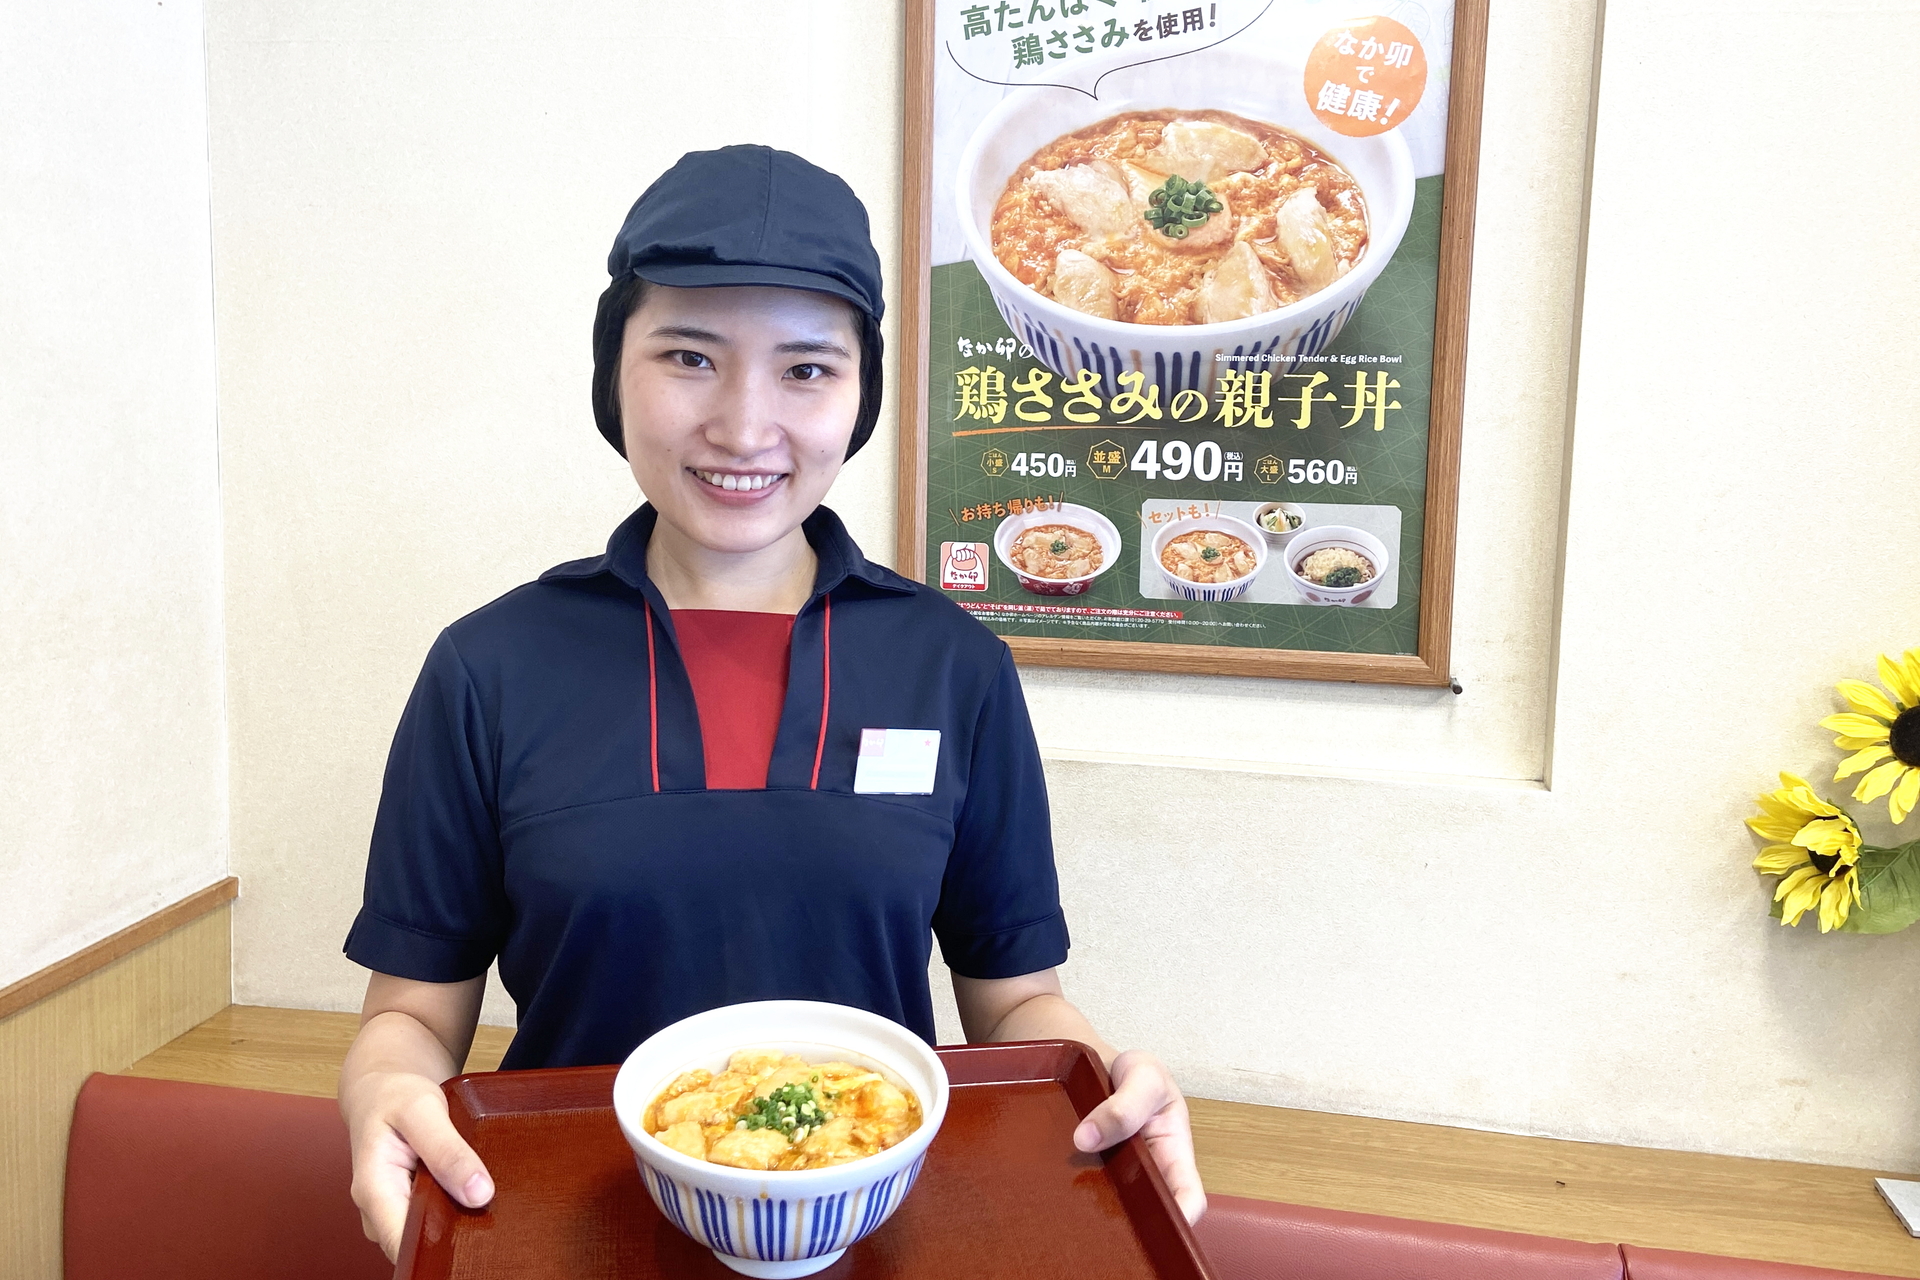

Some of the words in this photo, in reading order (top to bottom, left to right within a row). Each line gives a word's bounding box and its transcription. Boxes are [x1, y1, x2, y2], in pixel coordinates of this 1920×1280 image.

[1010, 3, 1217, 69] 鶏ささみを使用!
[1333, 29, 1414, 69] なか卯
[1355, 66, 1375, 84] で
[1316, 80, 1401, 125] 健康!
[957, 336, 1034, 362] なか卯の
[1215, 354, 1260, 363] Simmered
[1261, 354, 1296, 363] Chicken
[1299, 354, 1329, 363] Tender
[1330, 354, 1339, 363] &
[1340, 355, 1357, 365] Egg
[1358, 355, 1378, 364] Rice
[1379, 355, 1403, 364] Bowl
[953, 365, 1402, 432] 鶏ささみの親子丼
[986, 459, 1004, 467] 小盛
[1093, 450, 1122, 465] 並盛
[1102, 465, 1112, 474] M
[1260, 465, 1279, 475] 大盛
[960, 494, 1055, 523] お持ち帰りも!
[1148, 503, 1211, 524] セットも!
[950, 570, 979, 582] なか卯
